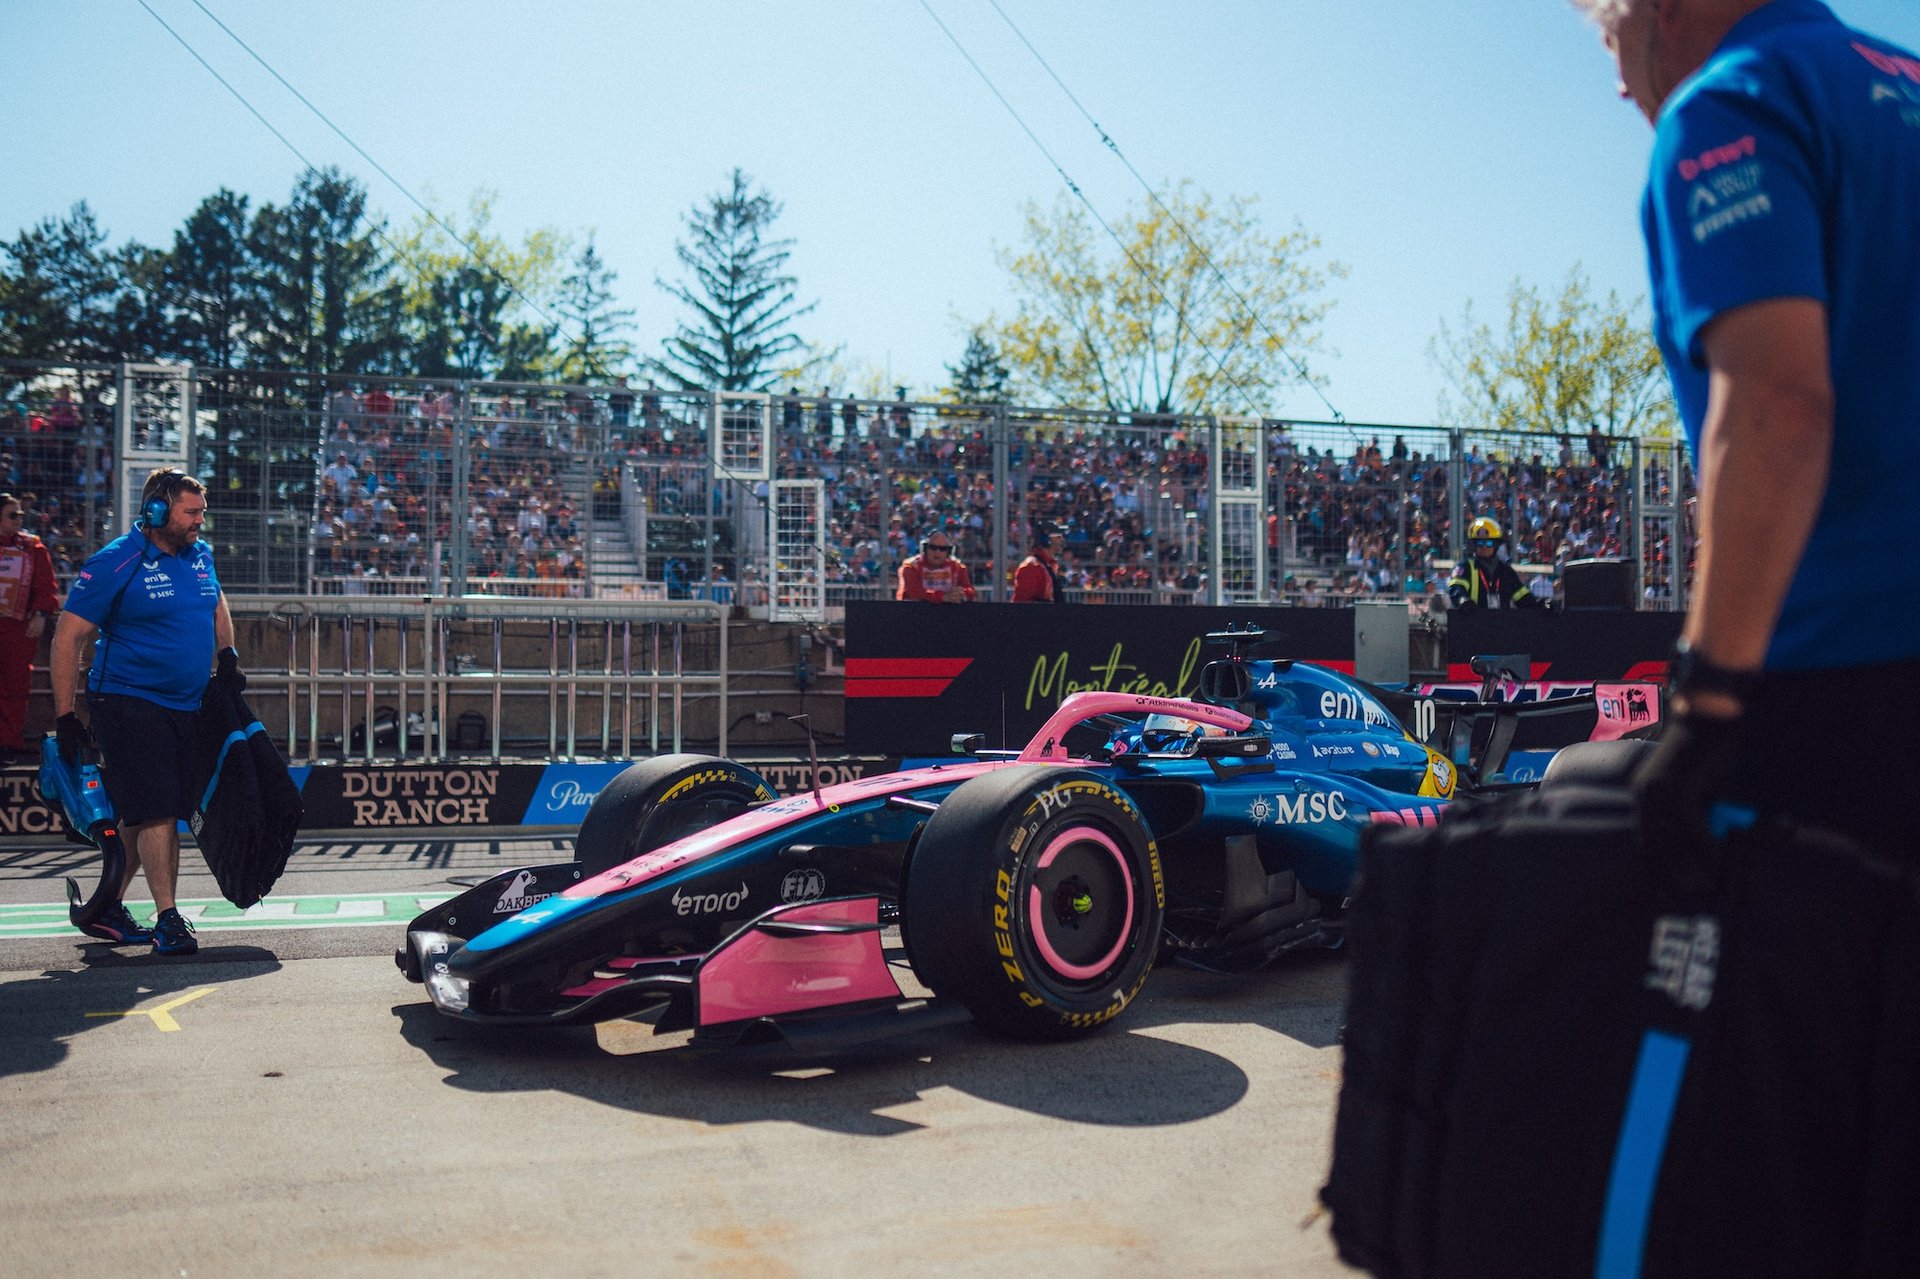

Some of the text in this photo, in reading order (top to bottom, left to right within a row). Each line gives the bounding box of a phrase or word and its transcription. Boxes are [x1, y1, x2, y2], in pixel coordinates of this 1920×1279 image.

[157, 589, 175, 598] MSC
[1025, 637, 1200, 710] Montréal
[1320, 690, 1357, 720] eni
[1602, 691, 1626, 719] eni
[1414, 699, 1436, 742] 10
[342, 769, 499, 798] DUTTON
[353, 798, 489, 826] RANCH
[1274, 790, 1347, 825] MSC
[783, 875, 821, 898] FIA
[994, 868, 1025, 983] ZERO
